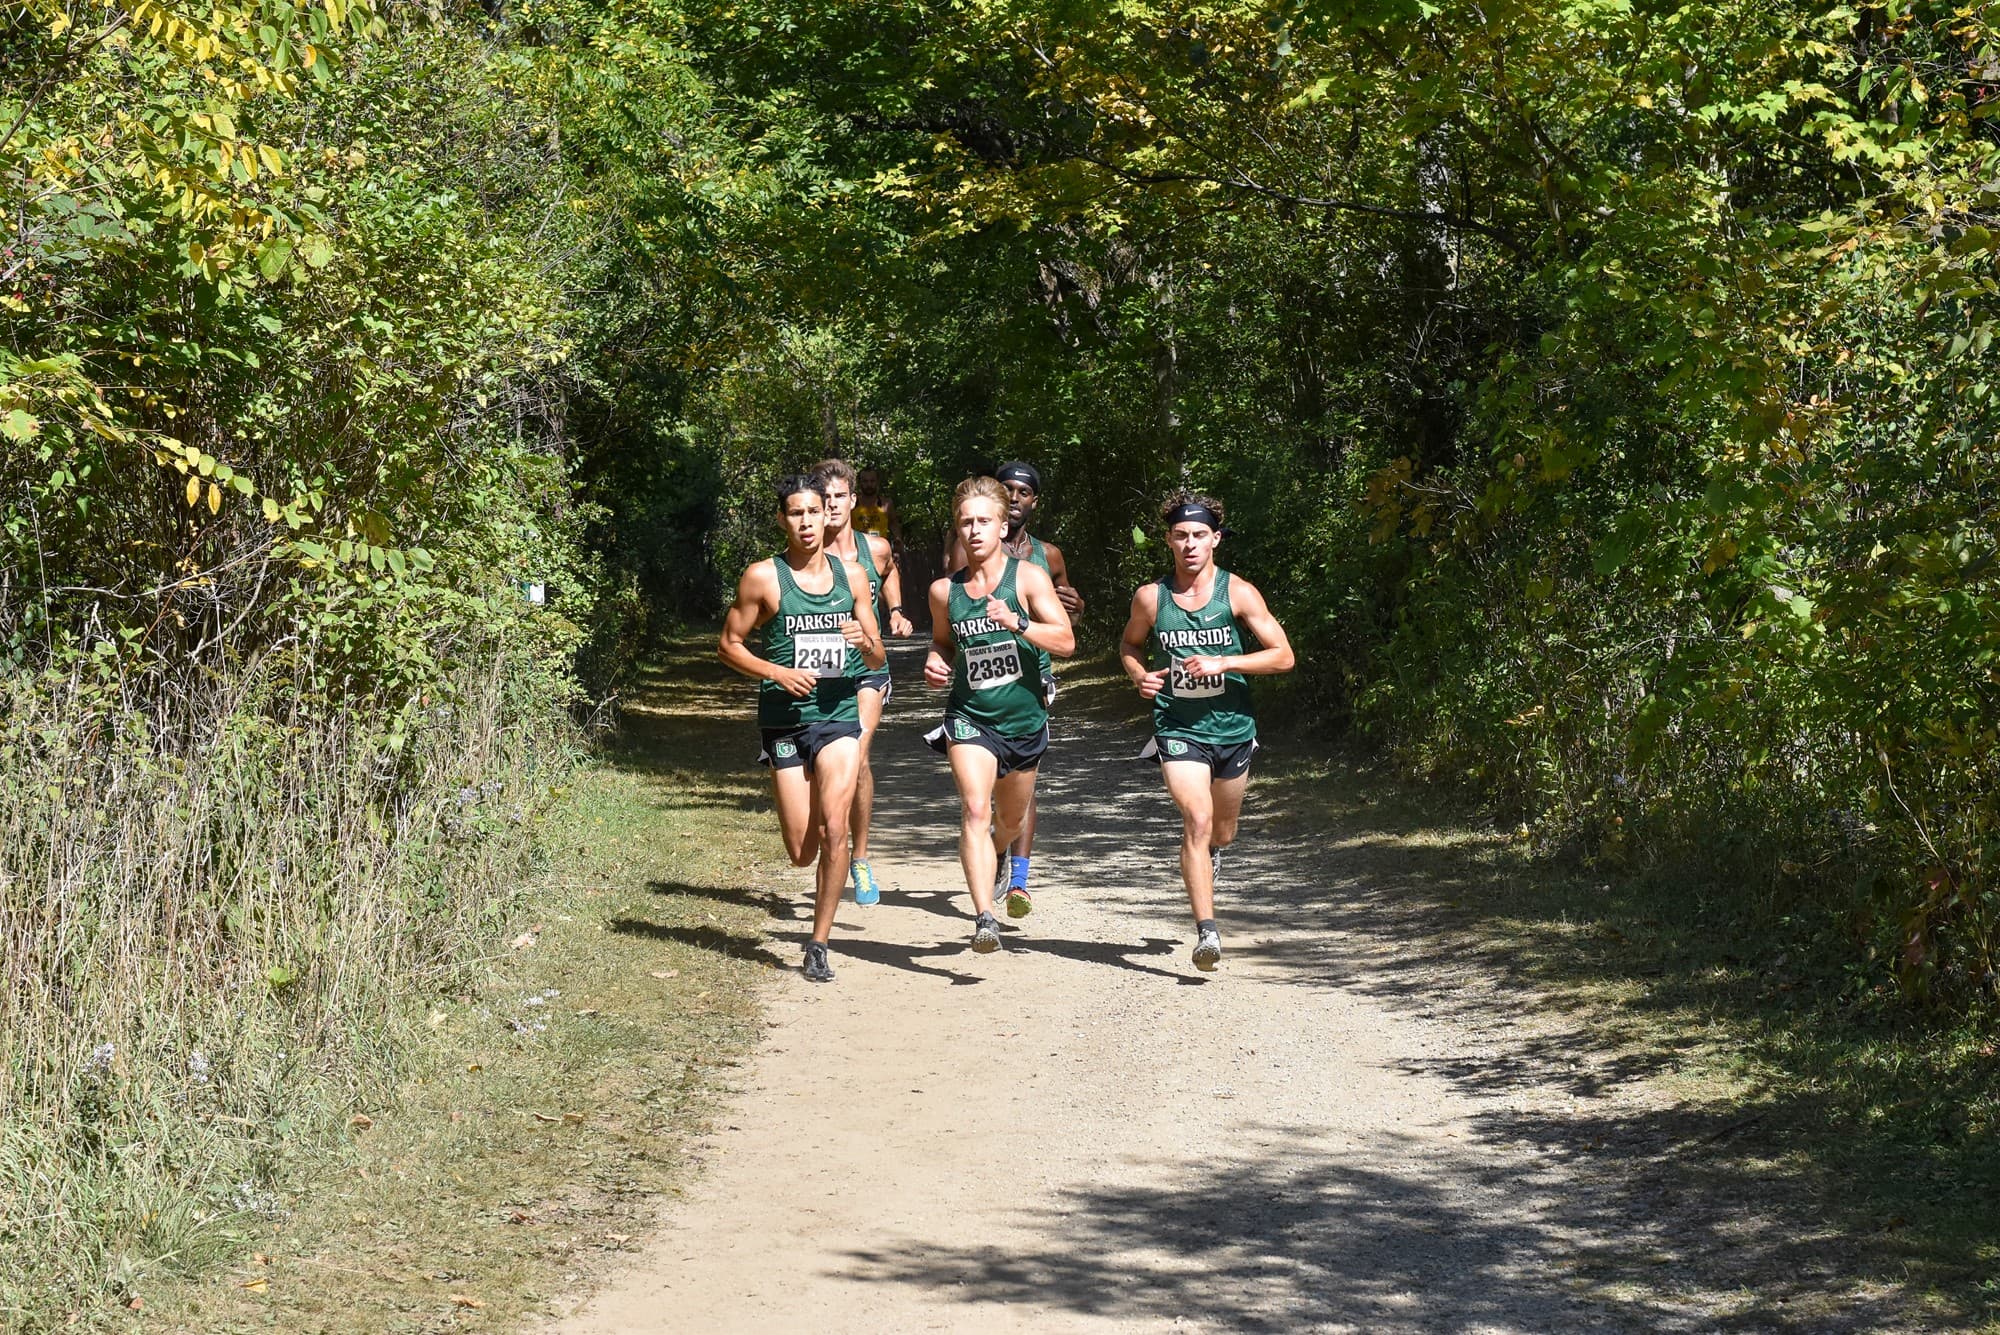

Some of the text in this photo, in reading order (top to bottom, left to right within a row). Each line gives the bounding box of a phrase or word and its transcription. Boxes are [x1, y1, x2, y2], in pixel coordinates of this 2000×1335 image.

[1160, 625, 1232, 651] PARKSIDE
[798, 648, 842, 669] 2341
[969, 655, 1019, 682] 2339
[1173, 671, 1222, 690] 2340
